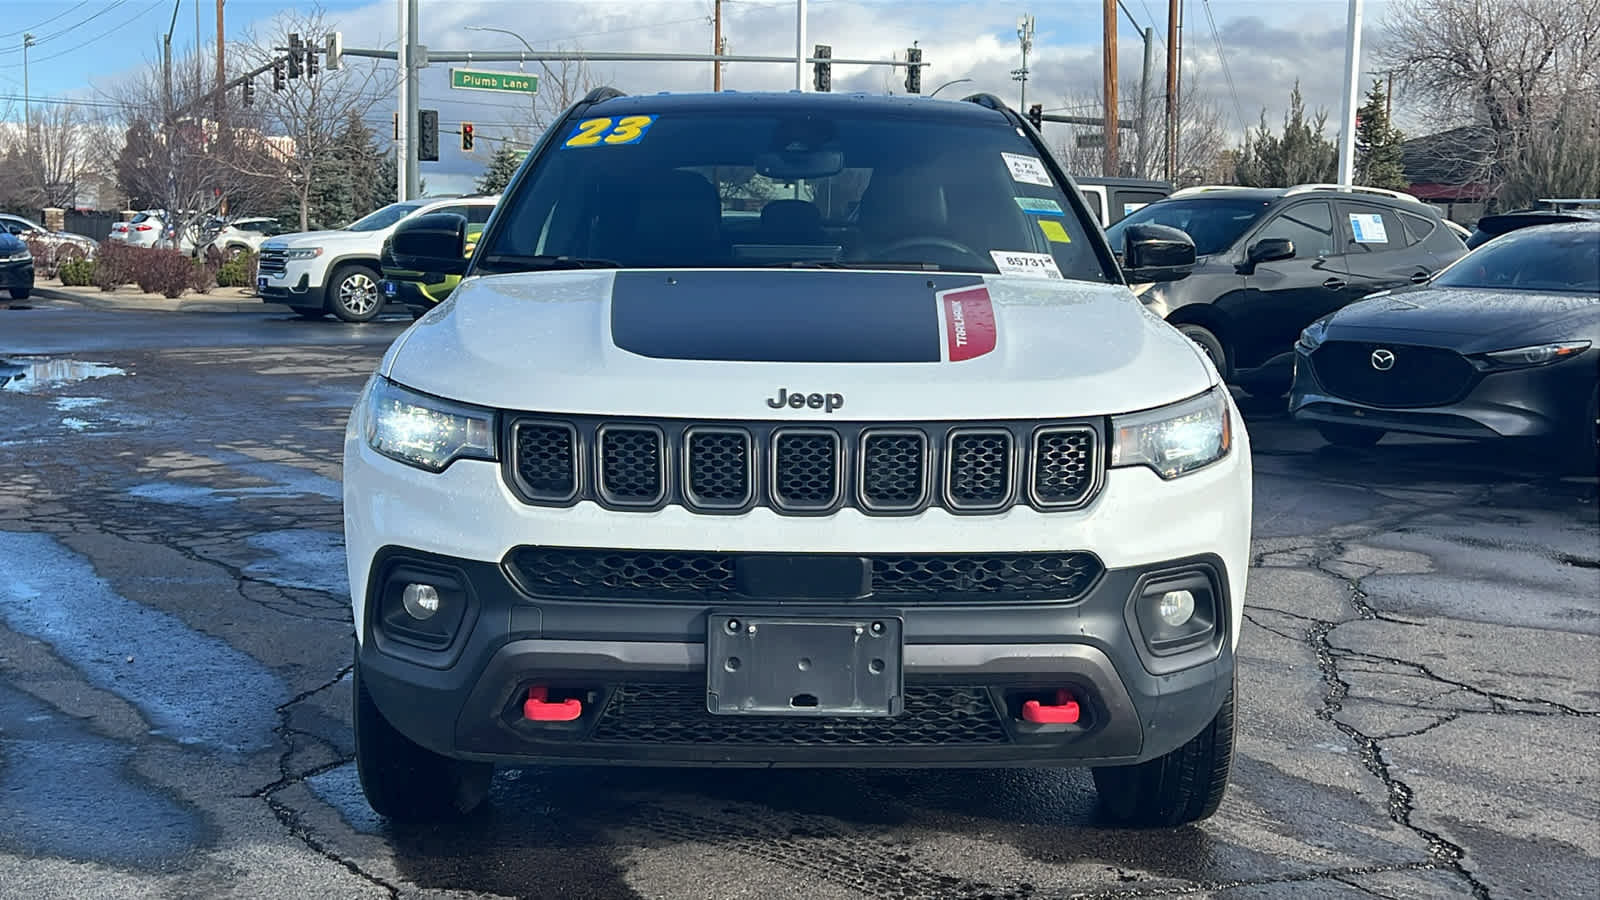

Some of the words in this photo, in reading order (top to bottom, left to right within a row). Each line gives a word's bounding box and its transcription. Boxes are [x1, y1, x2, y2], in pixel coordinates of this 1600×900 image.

[463, 75, 498, 87] Plumb
[502, 78, 529, 89] Lane
[566, 116, 652, 147] 23
[767, 388, 844, 413] Jeep
